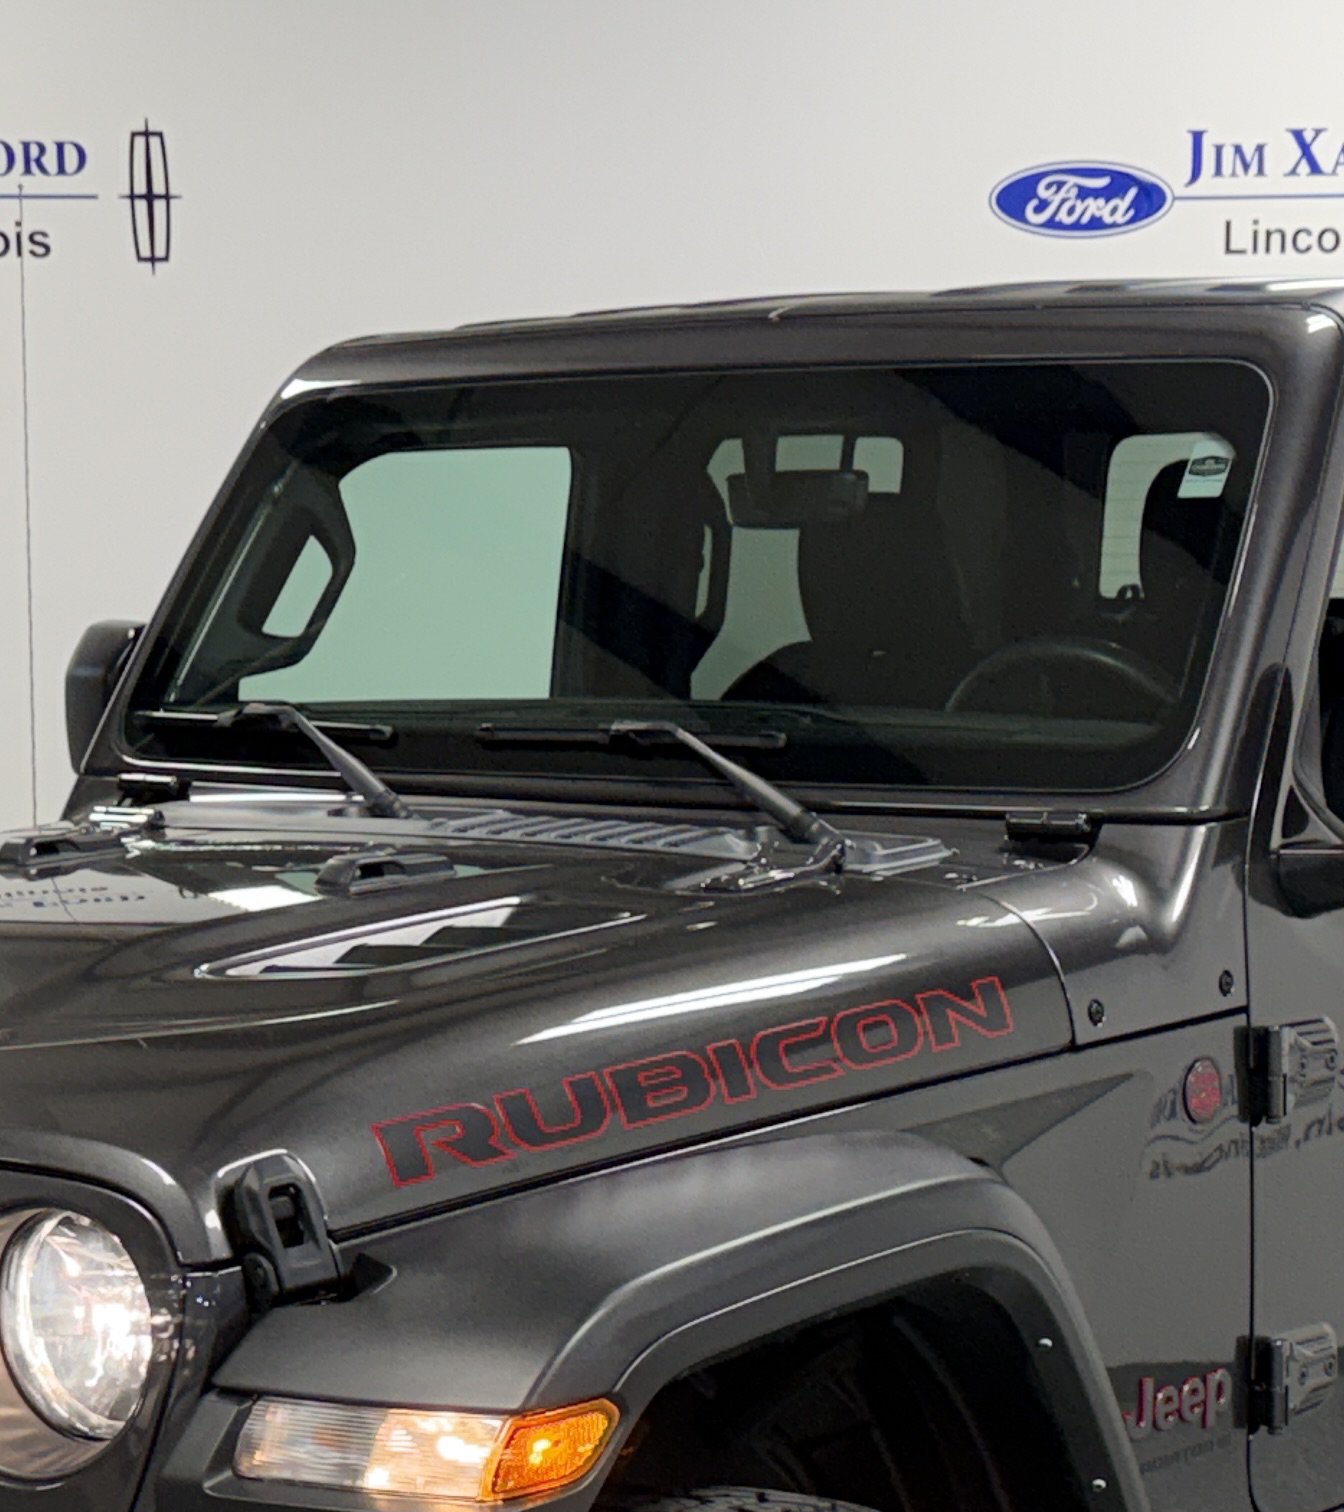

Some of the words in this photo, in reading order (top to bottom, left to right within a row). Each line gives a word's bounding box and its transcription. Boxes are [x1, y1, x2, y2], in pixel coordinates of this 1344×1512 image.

[1024, 172, 1136, 226] Ford
[371, 976, 1015, 1188] RUBICON
[1122, 1367, 1233, 1441] Jeep
